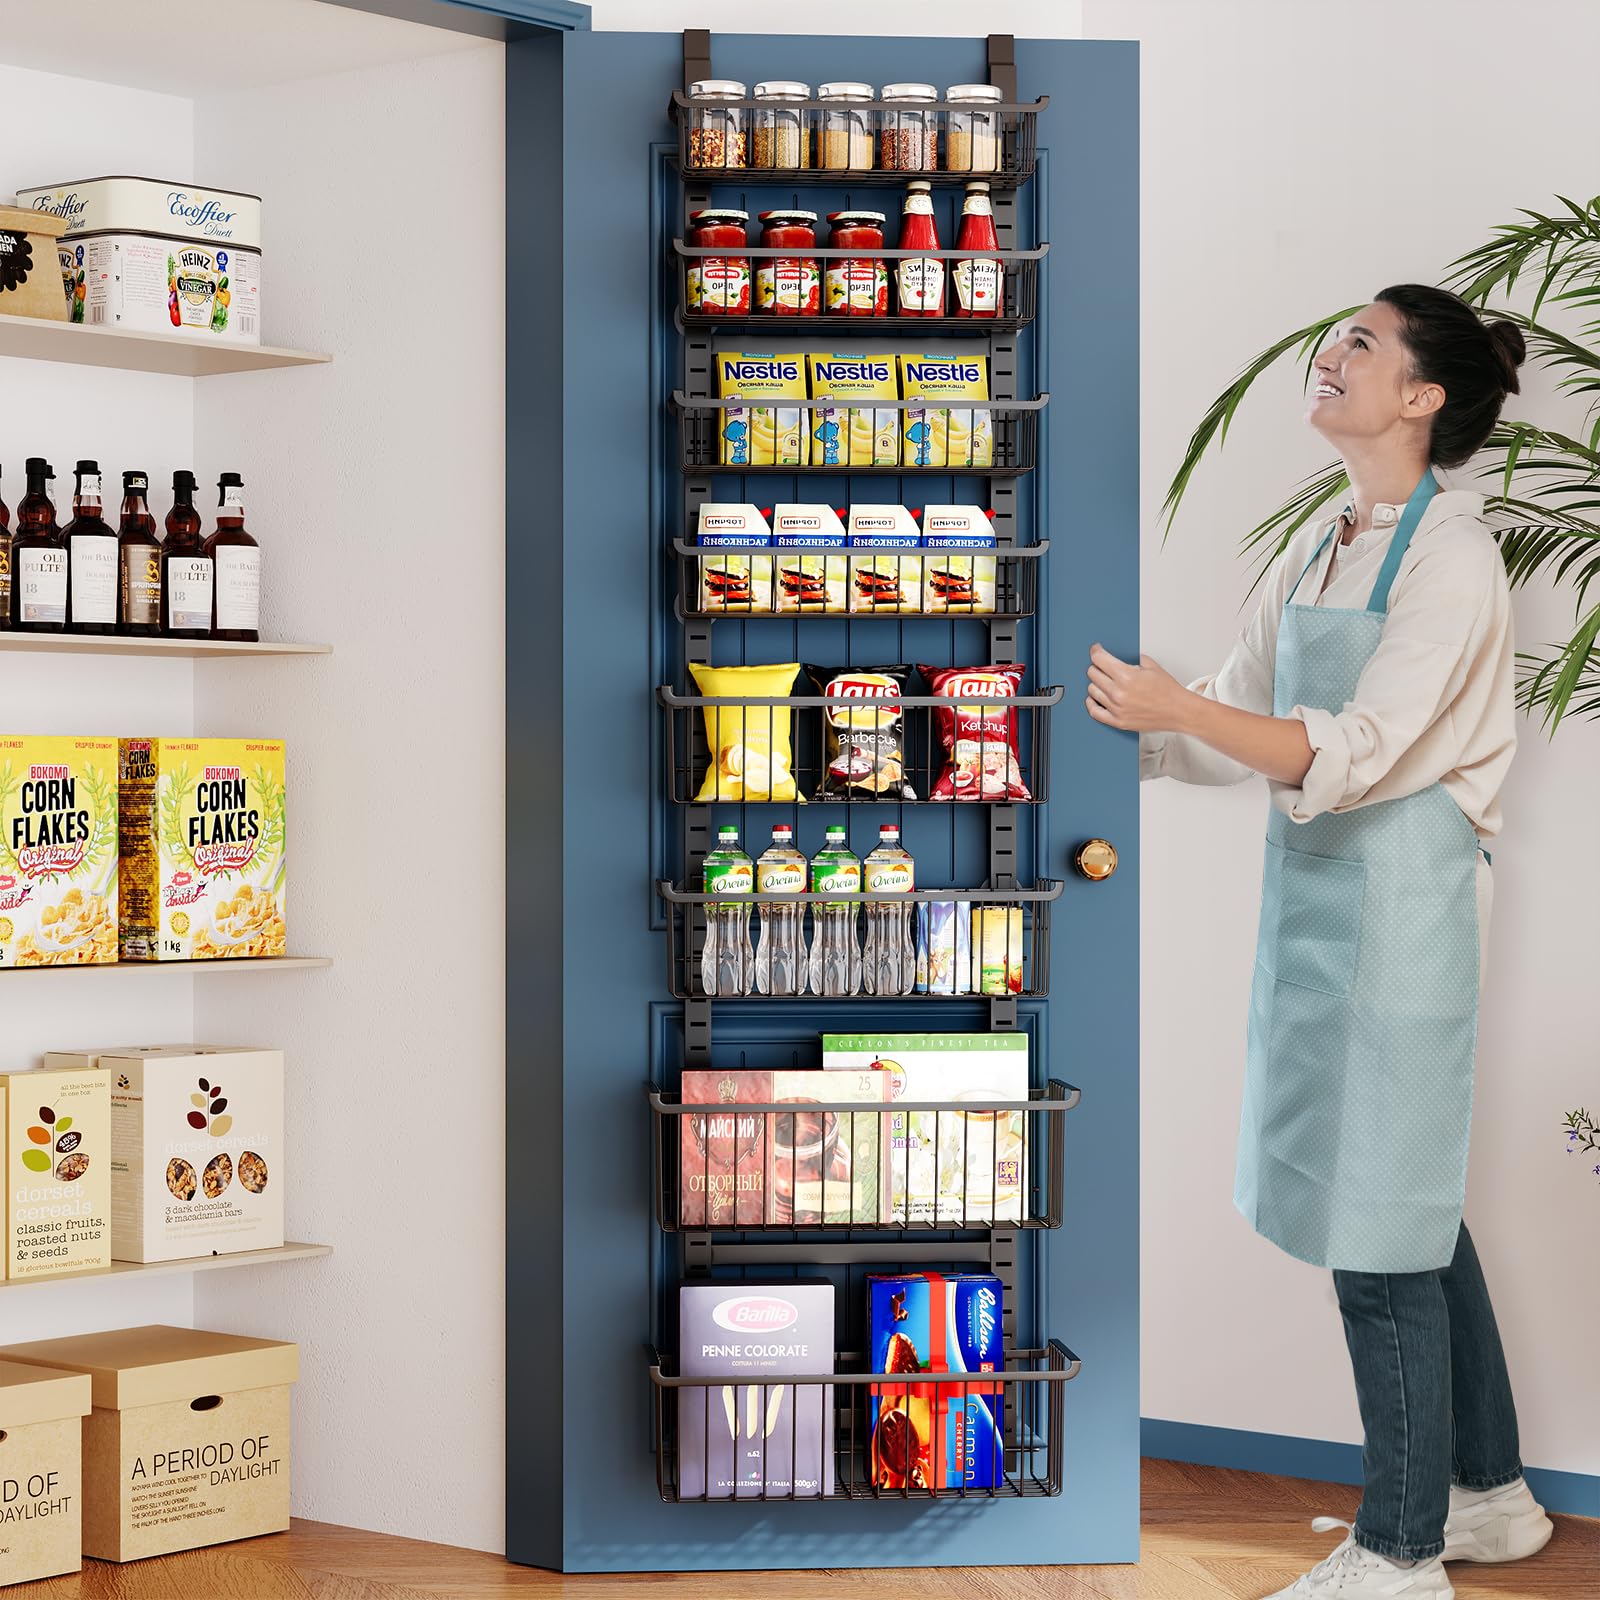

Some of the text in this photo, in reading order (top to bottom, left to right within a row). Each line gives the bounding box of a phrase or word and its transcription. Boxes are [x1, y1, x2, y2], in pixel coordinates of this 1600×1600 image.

[168, 192, 238, 226] Escoffier
[203, 222, 234, 238] Duett
[182, 252, 210, 270] HEINZ
[180, 281, 212, 294] VINEGAR
[724, 361, 798, 380] Nestlé
[816, 362, 888, 382] Nestlé
[906, 363, 980, 382] Nestlé
[25, 583, 38, 594] 18
[174, 592, 186, 601] 18
[129, 751, 150, 765] CORN
[30, 766, 68, 779] BOKOMO
[126, 764, 156, 780] FLAKES
[206, 768, 240, 780] BOKOMO
[22, 778, 76, 814] CORN
[198, 778, 246, 813] CORN
[13, 811, 89, 850] FLAKES
[189, 810, 258, 847] FLAKES
[18, 839, 84, 869] Original
[194, 837, 254, 867] Original
[165, 940, 181, 954] 1 kg
[858, 1076, 871, 1091] 25
[16, 1182, 82, 1204] dorset
[16, 1200, 92, 1222] cereals
[165, 1202, 232, 1214] 3 dark chocolate
[174, 1212, 222, 1222] macadamia
[224, 1208, 242, 1217] bars
[16, 1222, 62, 1234] classic
[17, 1230, 101, 1248] roasted nuts
[16, 1246, 68, 1260] & seeds
[736, 1305, 790, 1323] Barilla
[978, 1287, 996, 1360] Bahlsen
[702, 1344, 808, 1357] PENNE COLORATE
[966, 1403, 978, 1480] Carmen
[132, 1436, 269, 1480] A PERIOD OF
[177, 1474, 200, 1484] TOGETHER
[210, 1460, 280, 1486] DAYLIGHT
[28, 1472, 58, 1498] OF
